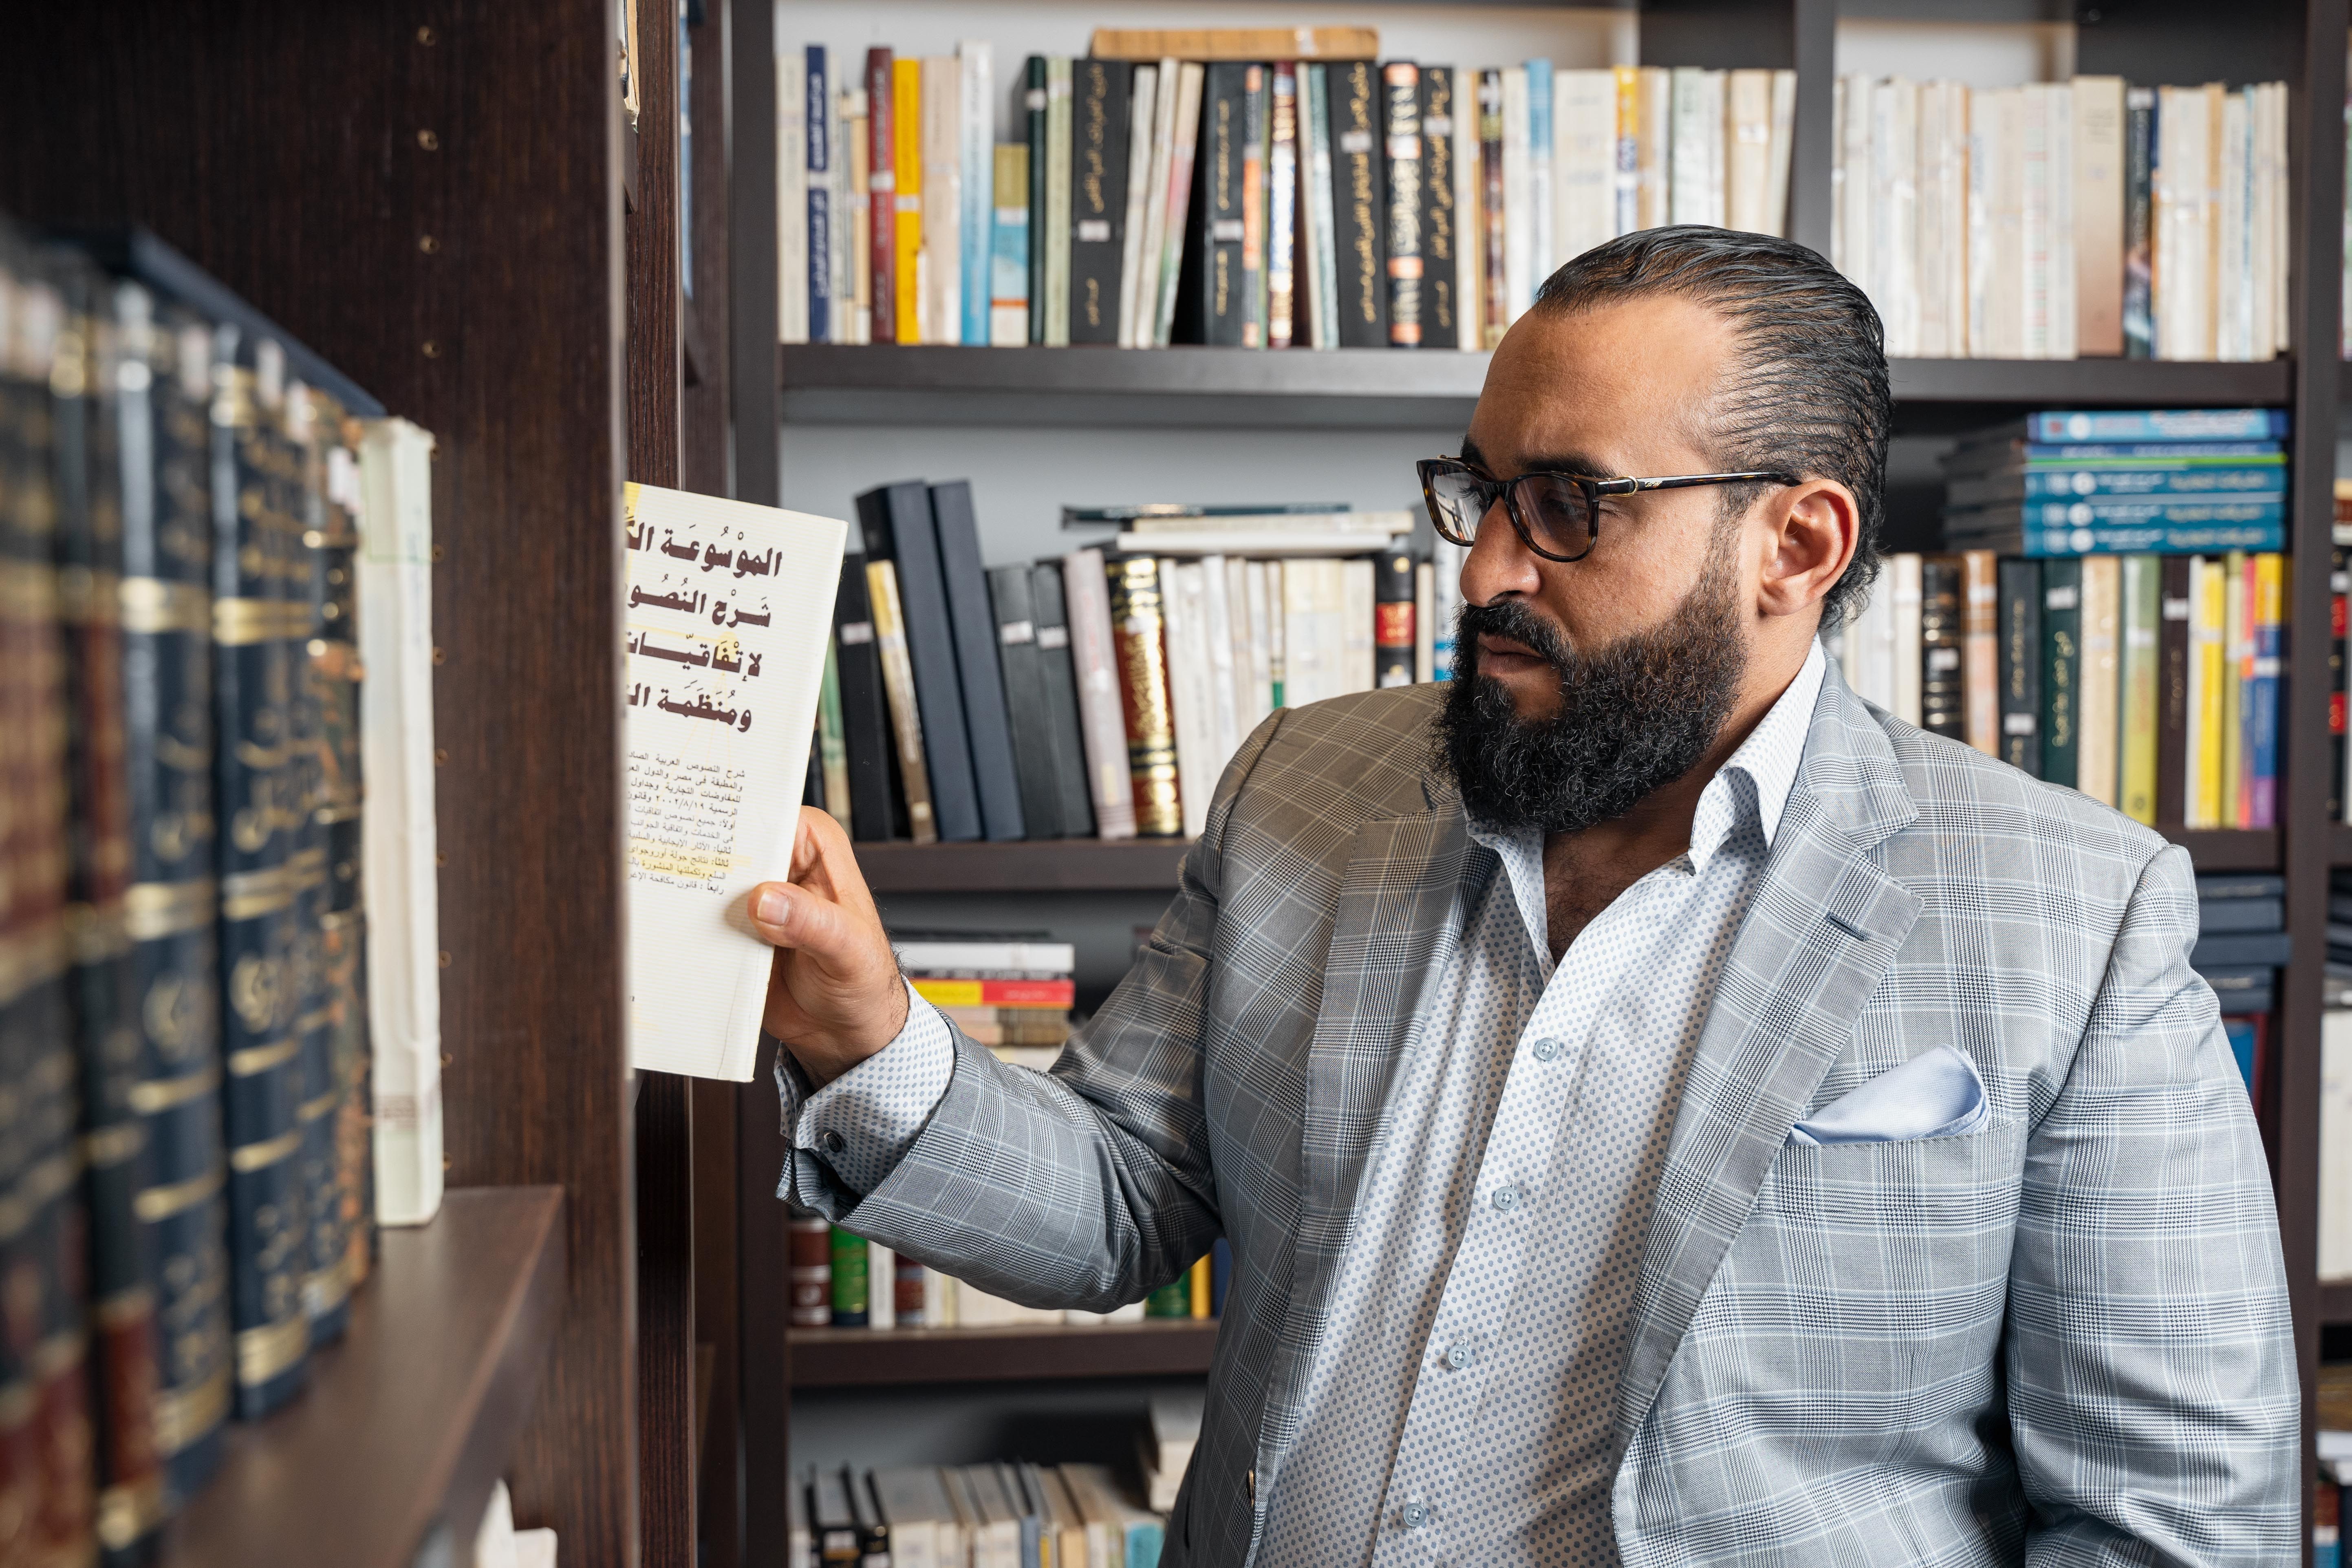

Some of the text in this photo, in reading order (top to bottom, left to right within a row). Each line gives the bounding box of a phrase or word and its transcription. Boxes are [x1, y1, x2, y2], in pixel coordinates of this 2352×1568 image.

[627, 573, 707, 614] النُصُو
[626, 764, 639, 773] العر
[627, 751, 745, 778] شرح النصوص العربية الصاد
[644, 766, 669, 779] والدول
[665, 782, 694, 795] التجارية
[711, 777, 743, 792] والمطبقة
[701, 791, 741, 803] للمفاوضات
[709, 803, 738, 817] الرسمية
[642, 860, 673, 871] المنشورة
[707, 871, 726, 881] السلع
